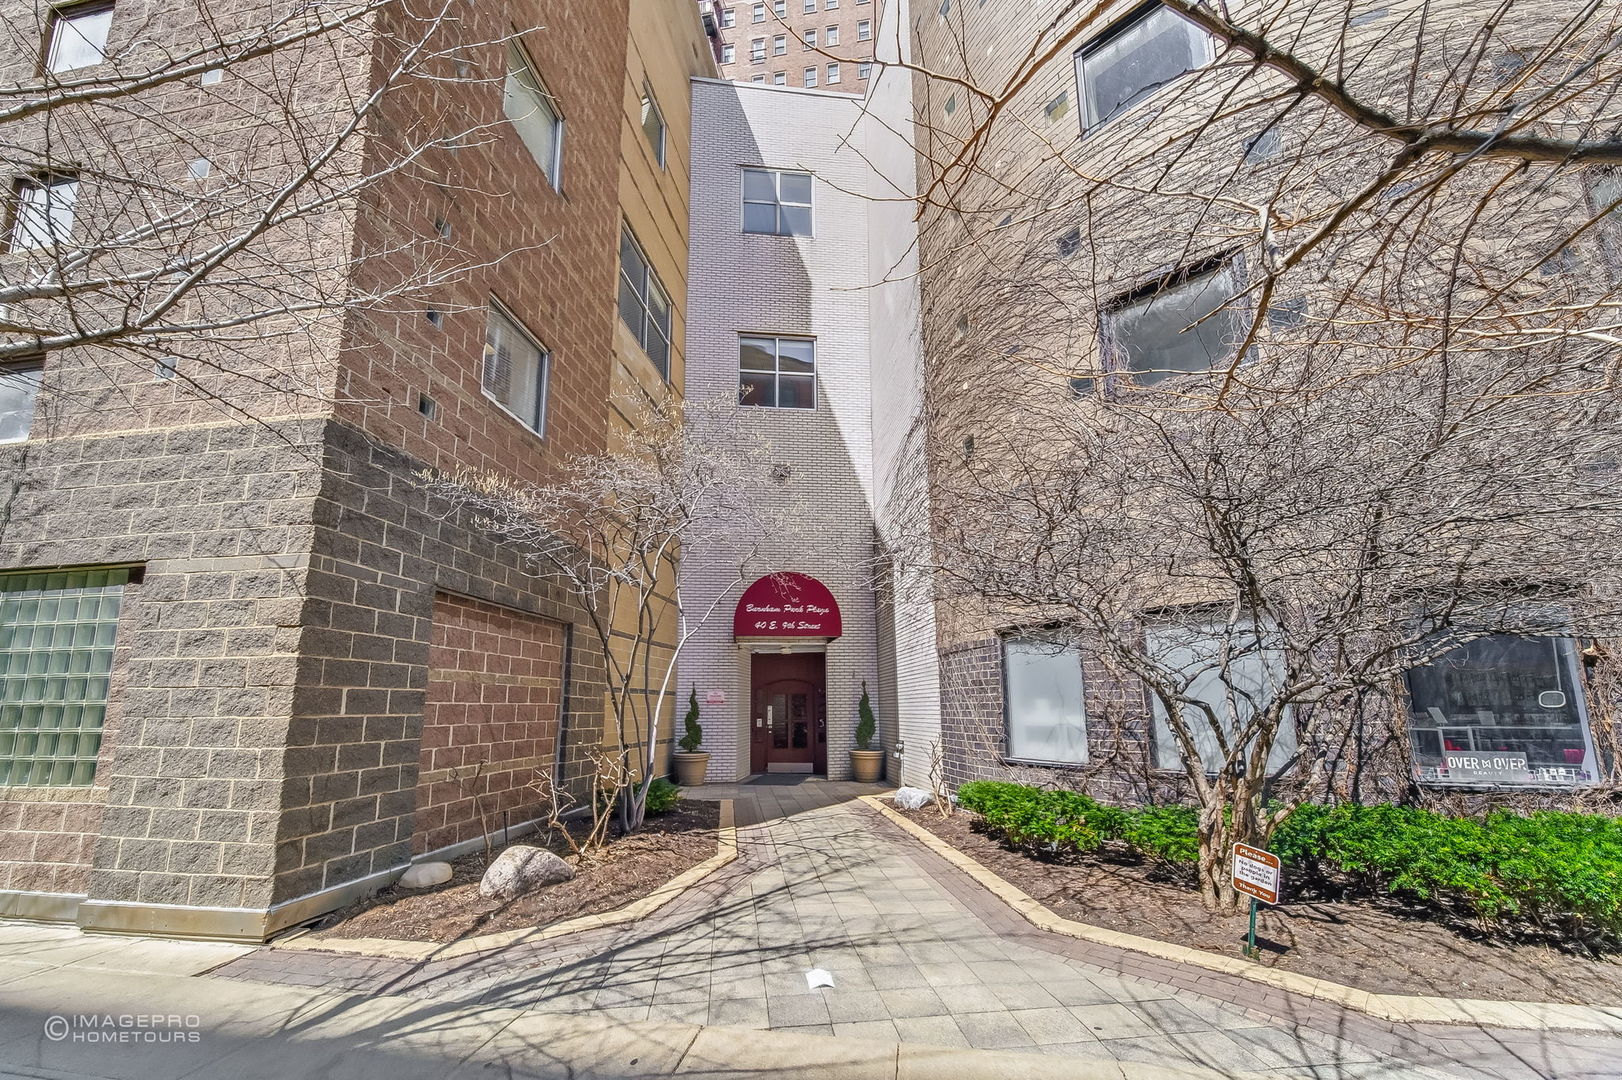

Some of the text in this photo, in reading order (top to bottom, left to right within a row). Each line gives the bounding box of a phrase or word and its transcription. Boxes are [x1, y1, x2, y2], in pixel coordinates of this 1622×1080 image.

[746, 603, 830, 616] Burnham Park Plaza
[754, 621, 821, 630] 40 E. 9th Street
[1447, 756, 1527, 771] OVER OVER
[1241, 866, 1263, 878] people
[1249, 862, 1265, 873] dogs
[1250, 875, 1272, 887] garden
[1239, 882, 1271, 899] Thank You
